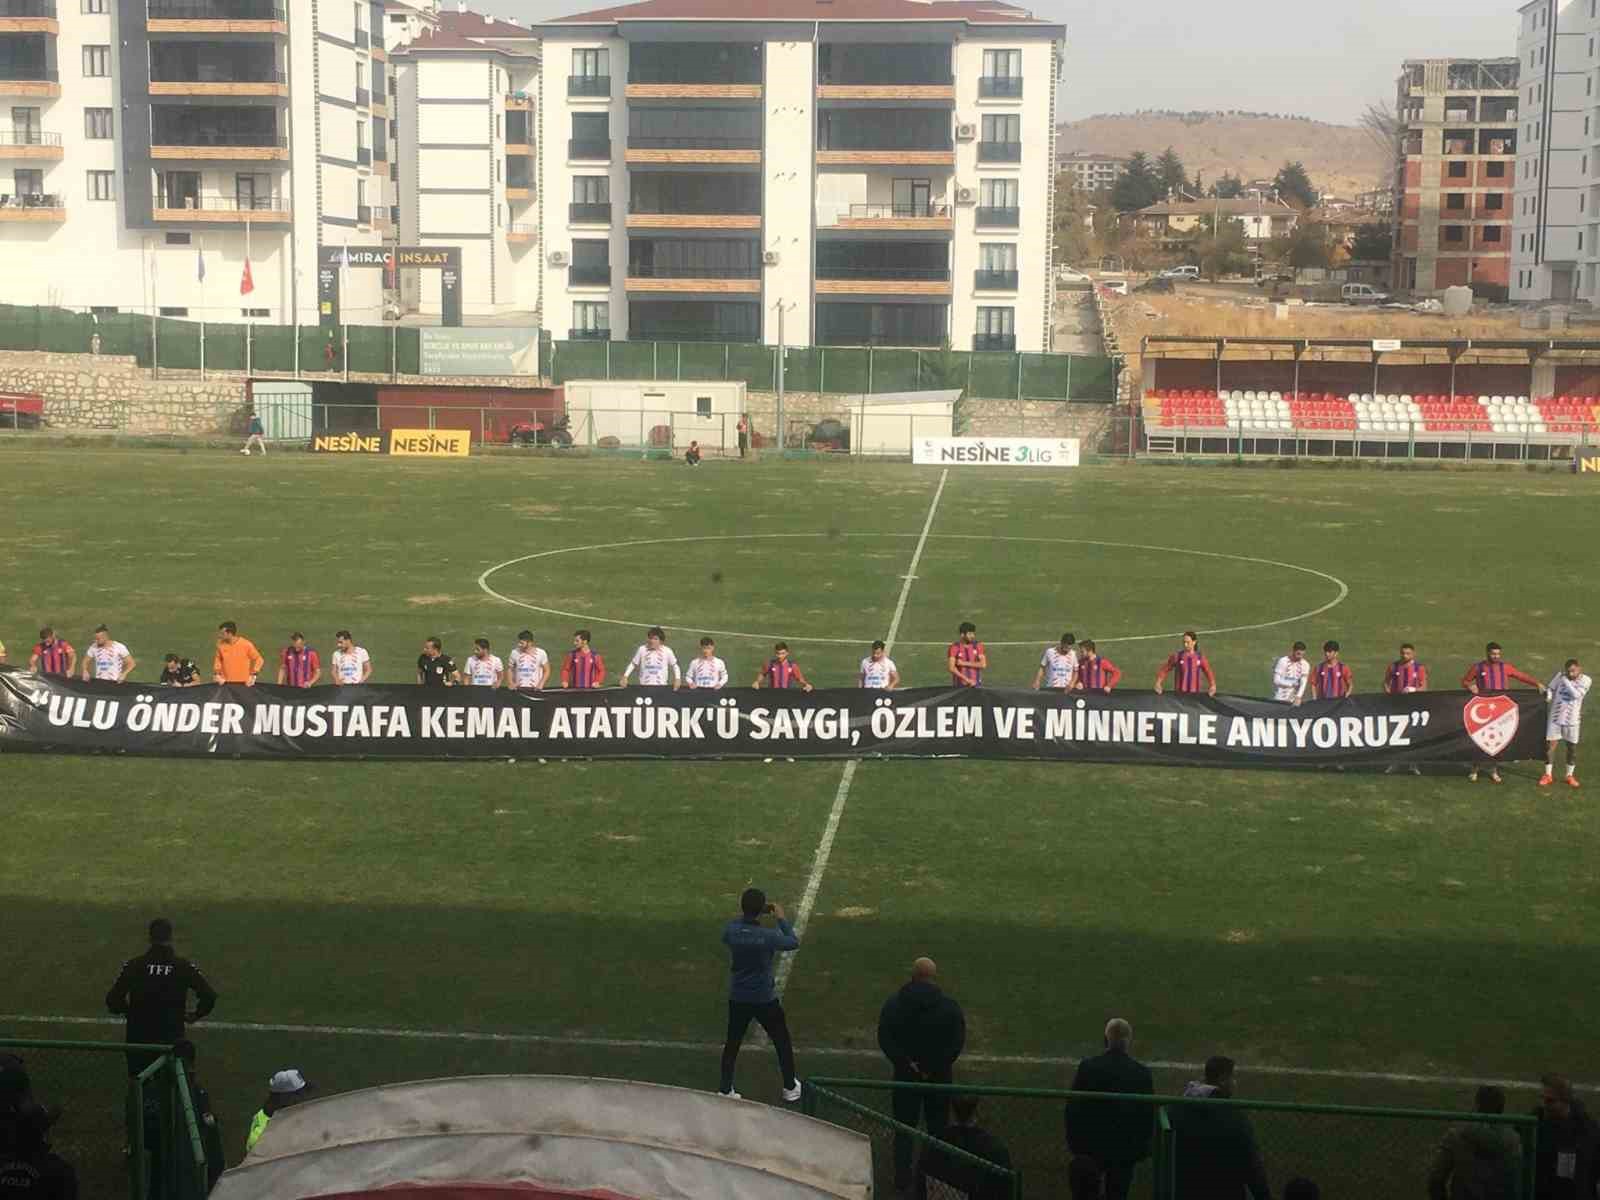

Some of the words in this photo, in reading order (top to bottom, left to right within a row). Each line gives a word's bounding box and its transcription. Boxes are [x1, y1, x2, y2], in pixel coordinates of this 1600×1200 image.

[127, 694, 245, 734] ÖNDER
[253, 703, 412, 738] MUSTAFA
[421, 706, 540, 738] KEMAL
[549, 697, 739, 739] ATATÜRK'Ü
[749, 707, 861, 746] SAYGI,
[871, 698, 983, 739] ÖZLEM
[993, 707, 1035, 739] VE
[1044, 698, 1218, 745] MİNNETLE
[146, 963, 174, 977] TFF
